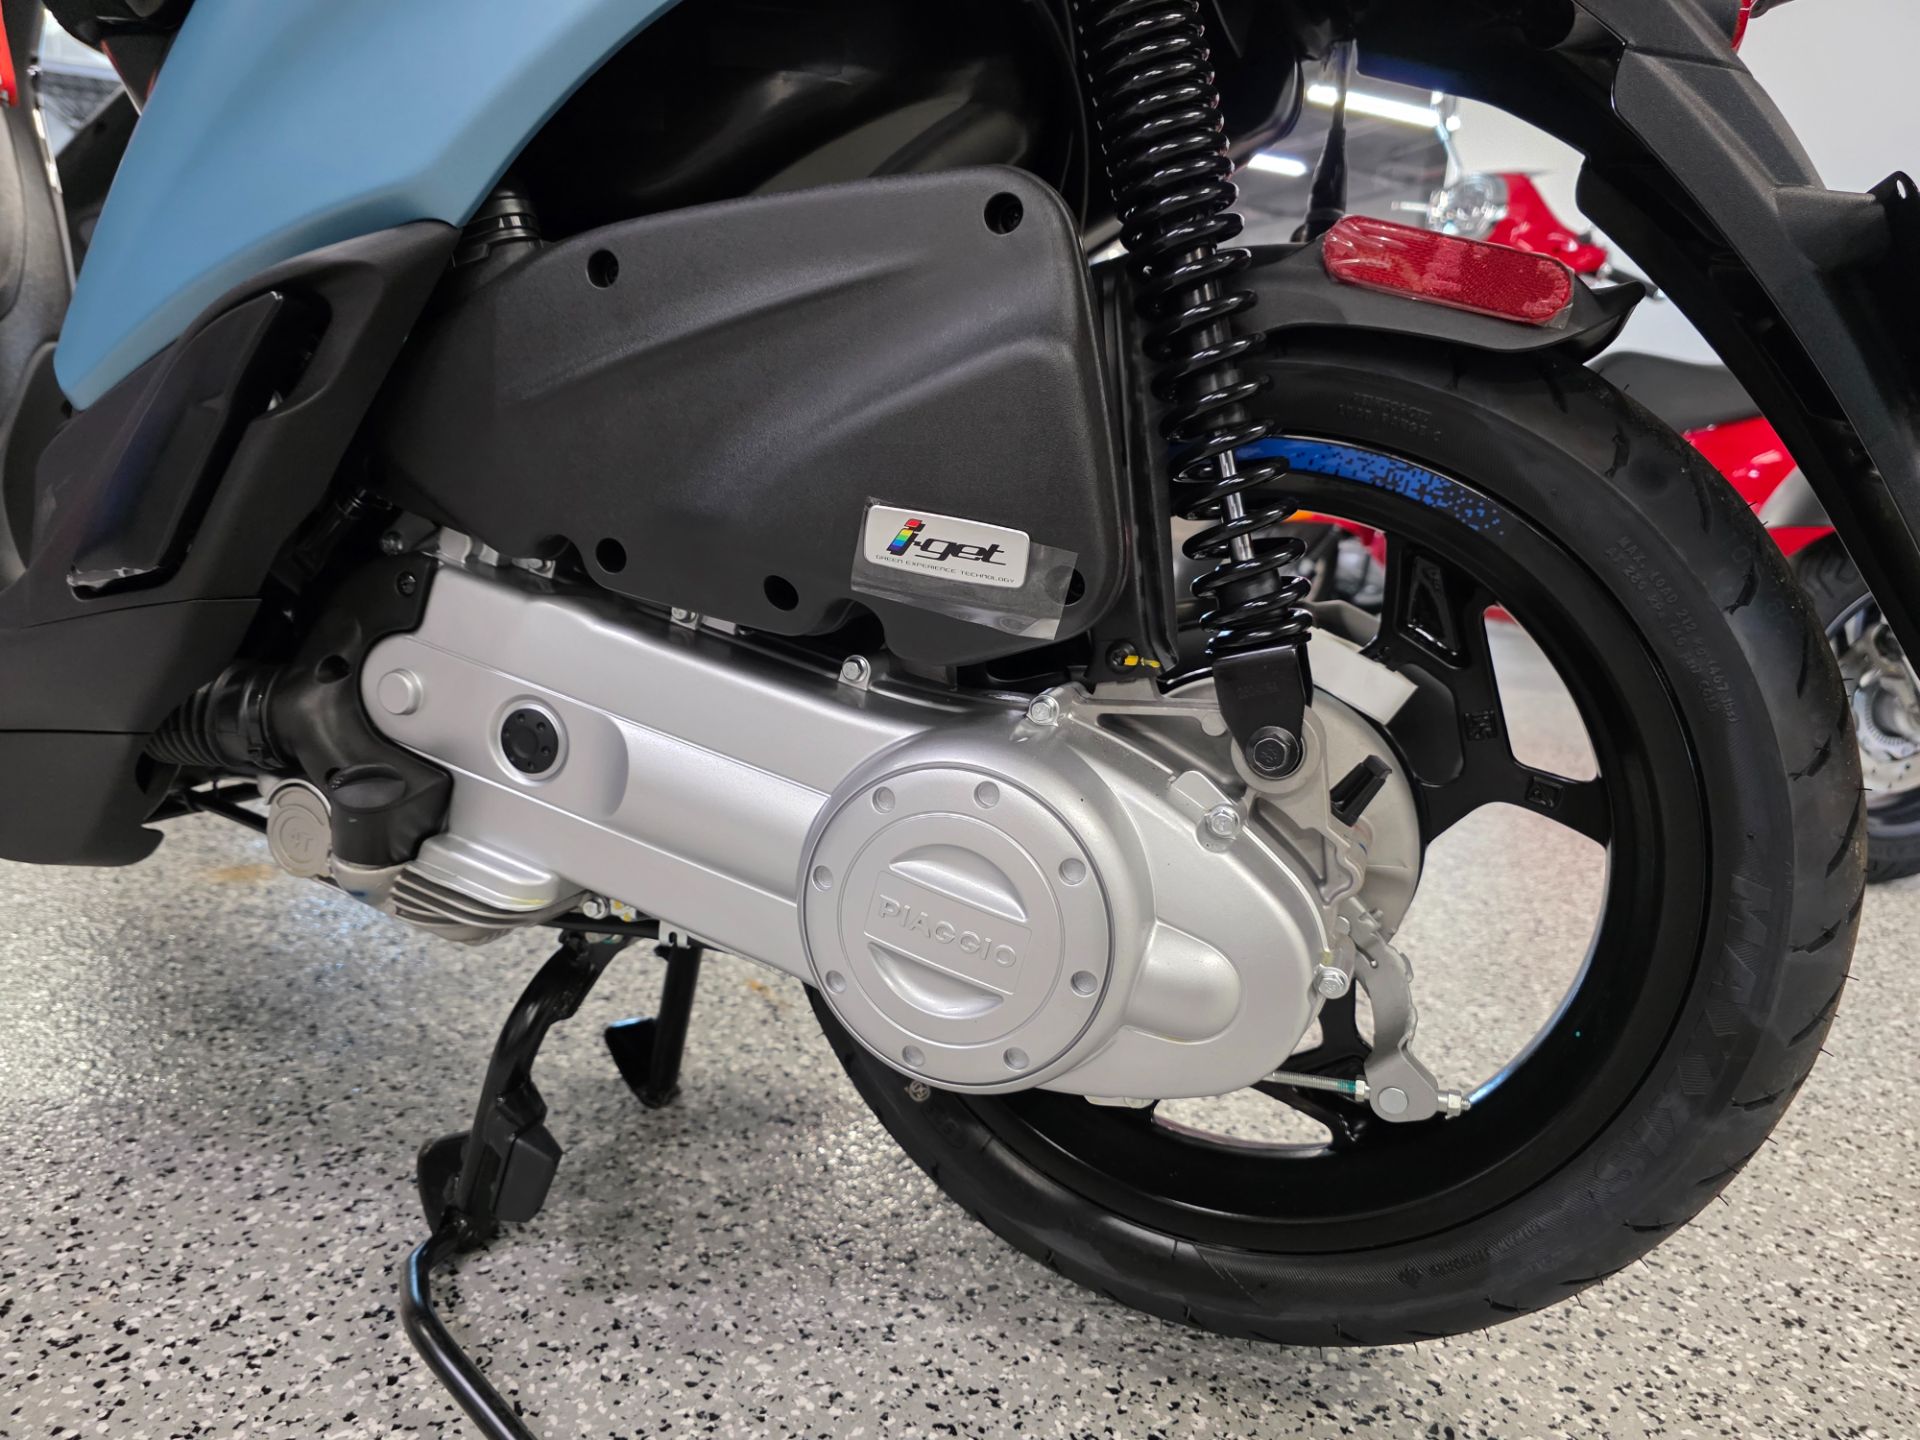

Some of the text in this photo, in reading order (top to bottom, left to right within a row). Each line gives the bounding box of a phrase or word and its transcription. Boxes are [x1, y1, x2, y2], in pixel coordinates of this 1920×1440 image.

[886, 518, 1007, 566] i-get
[875, 554, 1016, 584] GREEN EXPERIENCE TECHNOLOGY
[878, 893, 1018, 968] PIAGGIO
